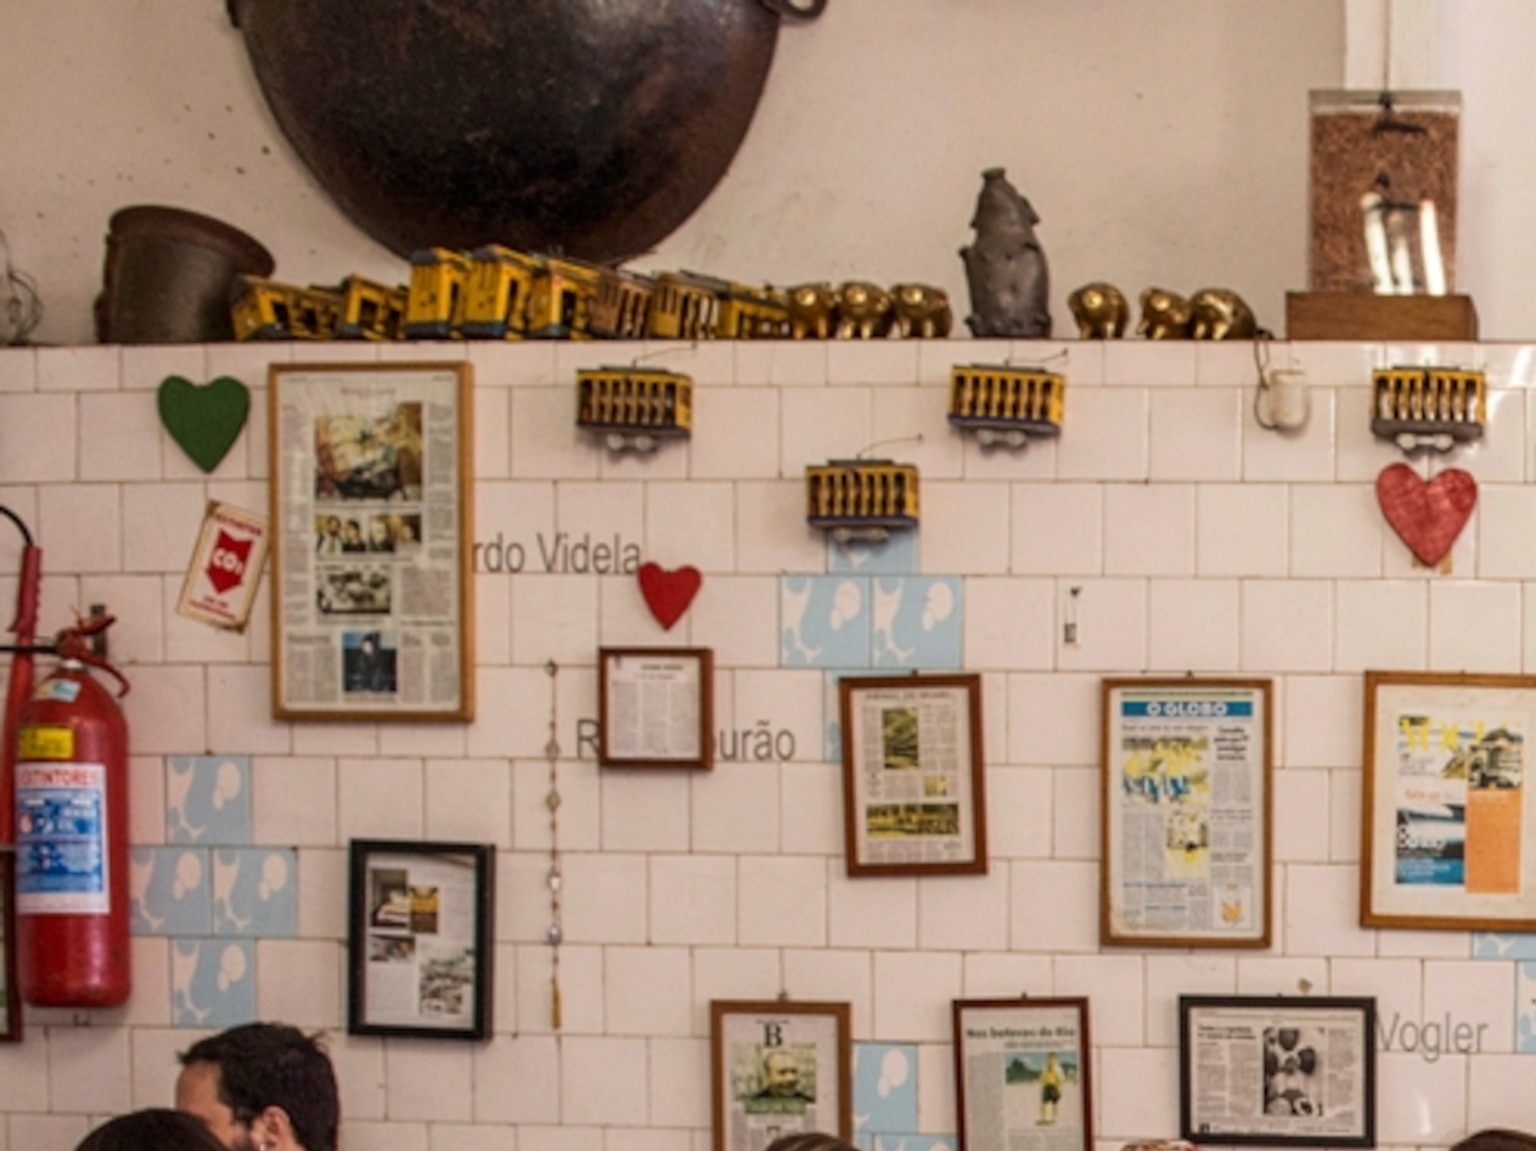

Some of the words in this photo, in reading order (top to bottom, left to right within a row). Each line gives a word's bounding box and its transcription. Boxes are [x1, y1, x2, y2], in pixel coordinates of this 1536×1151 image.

[472, 533, 525, 574] rdo
[537, 533, 641, 574] Videla
[718, 720, 796, 761] urão
[764, 1023, 782, 1047] B
[1376, 1012, 1489, 1062] Vogler
